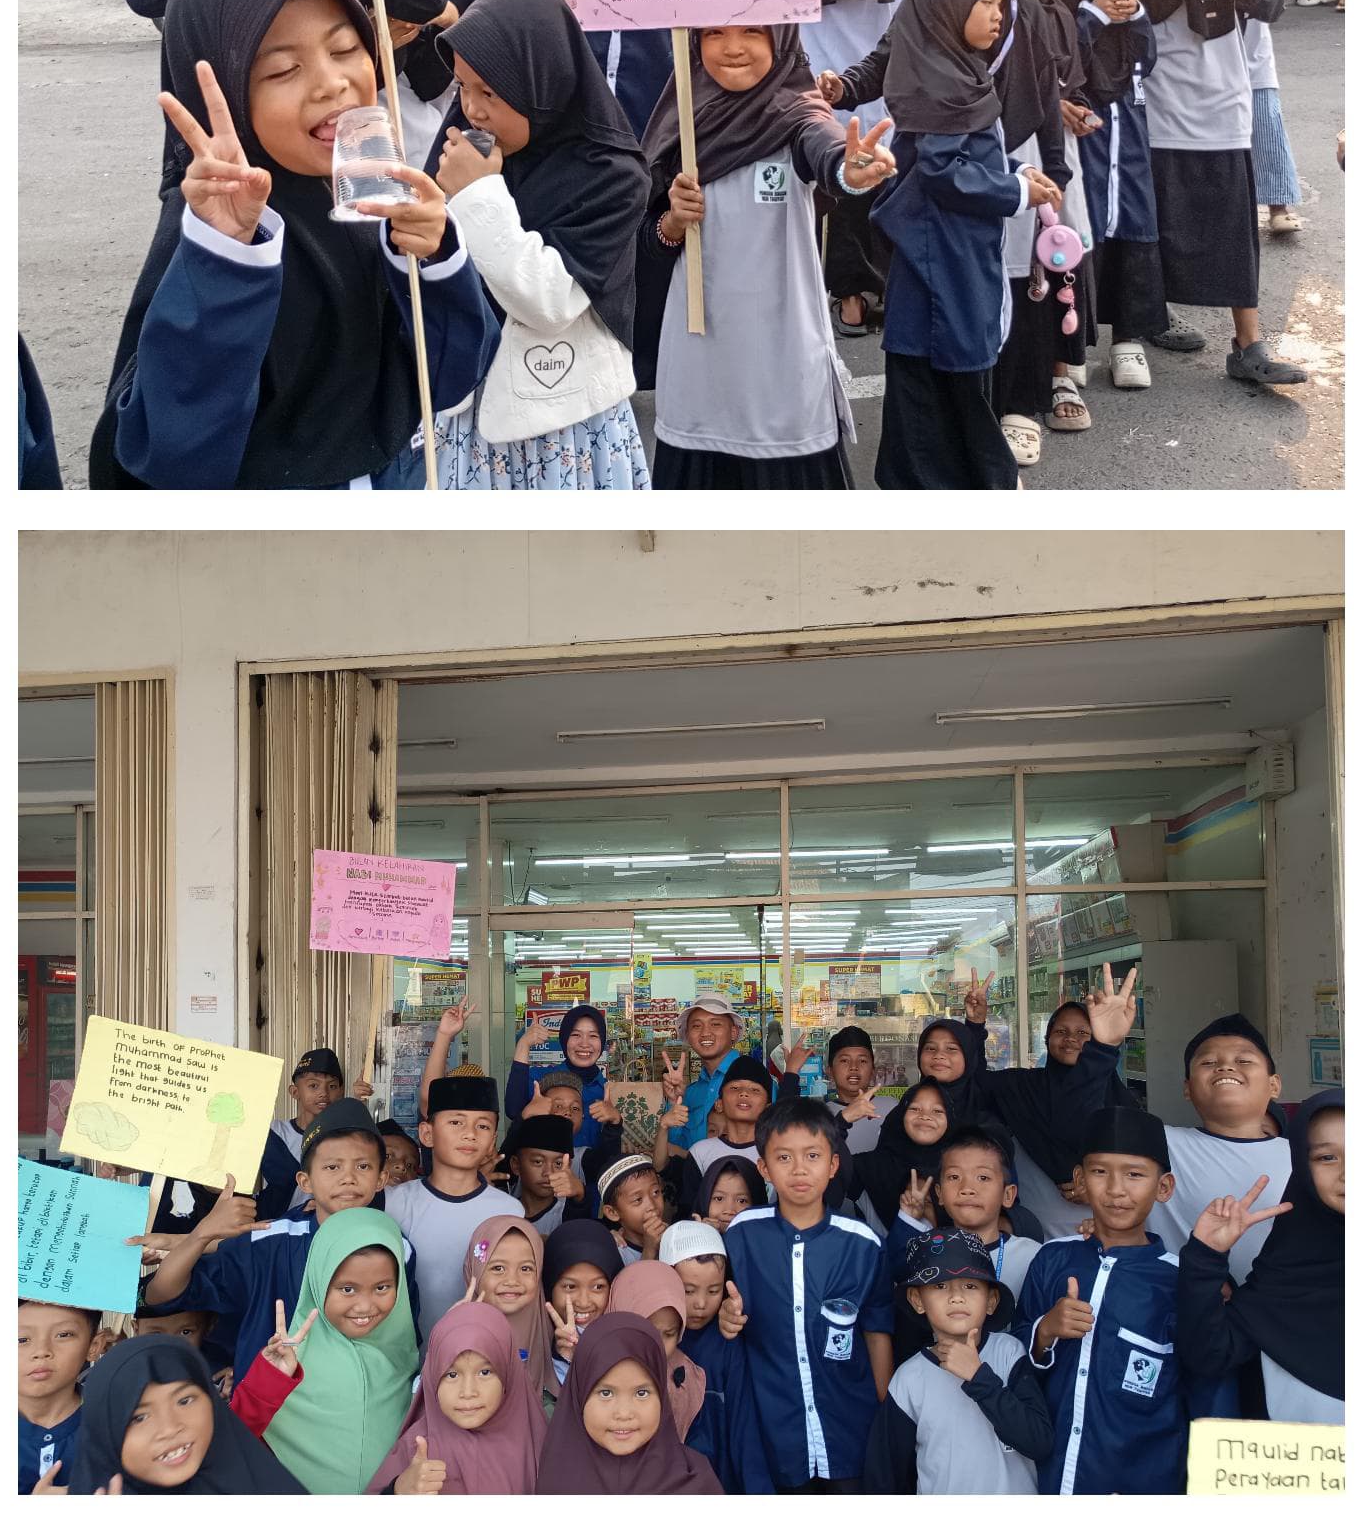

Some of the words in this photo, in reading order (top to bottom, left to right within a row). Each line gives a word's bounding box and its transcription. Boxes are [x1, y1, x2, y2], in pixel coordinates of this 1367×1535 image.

[534, 359, 565, 371] daim
[552, 977, 580, 990] PWP
[114, 1028, 136, 1041] The
[142, 1032, 166, 1049] birth
[113, 1054, 132, 1066] the
[136, 1060, 162, 1073] most
[140, 1071, 158, 1083] that
[195, 1085, 207, 1093] us
[108, 1089, 125, 1100] the
[131, 1093, 160, 1108] bright
